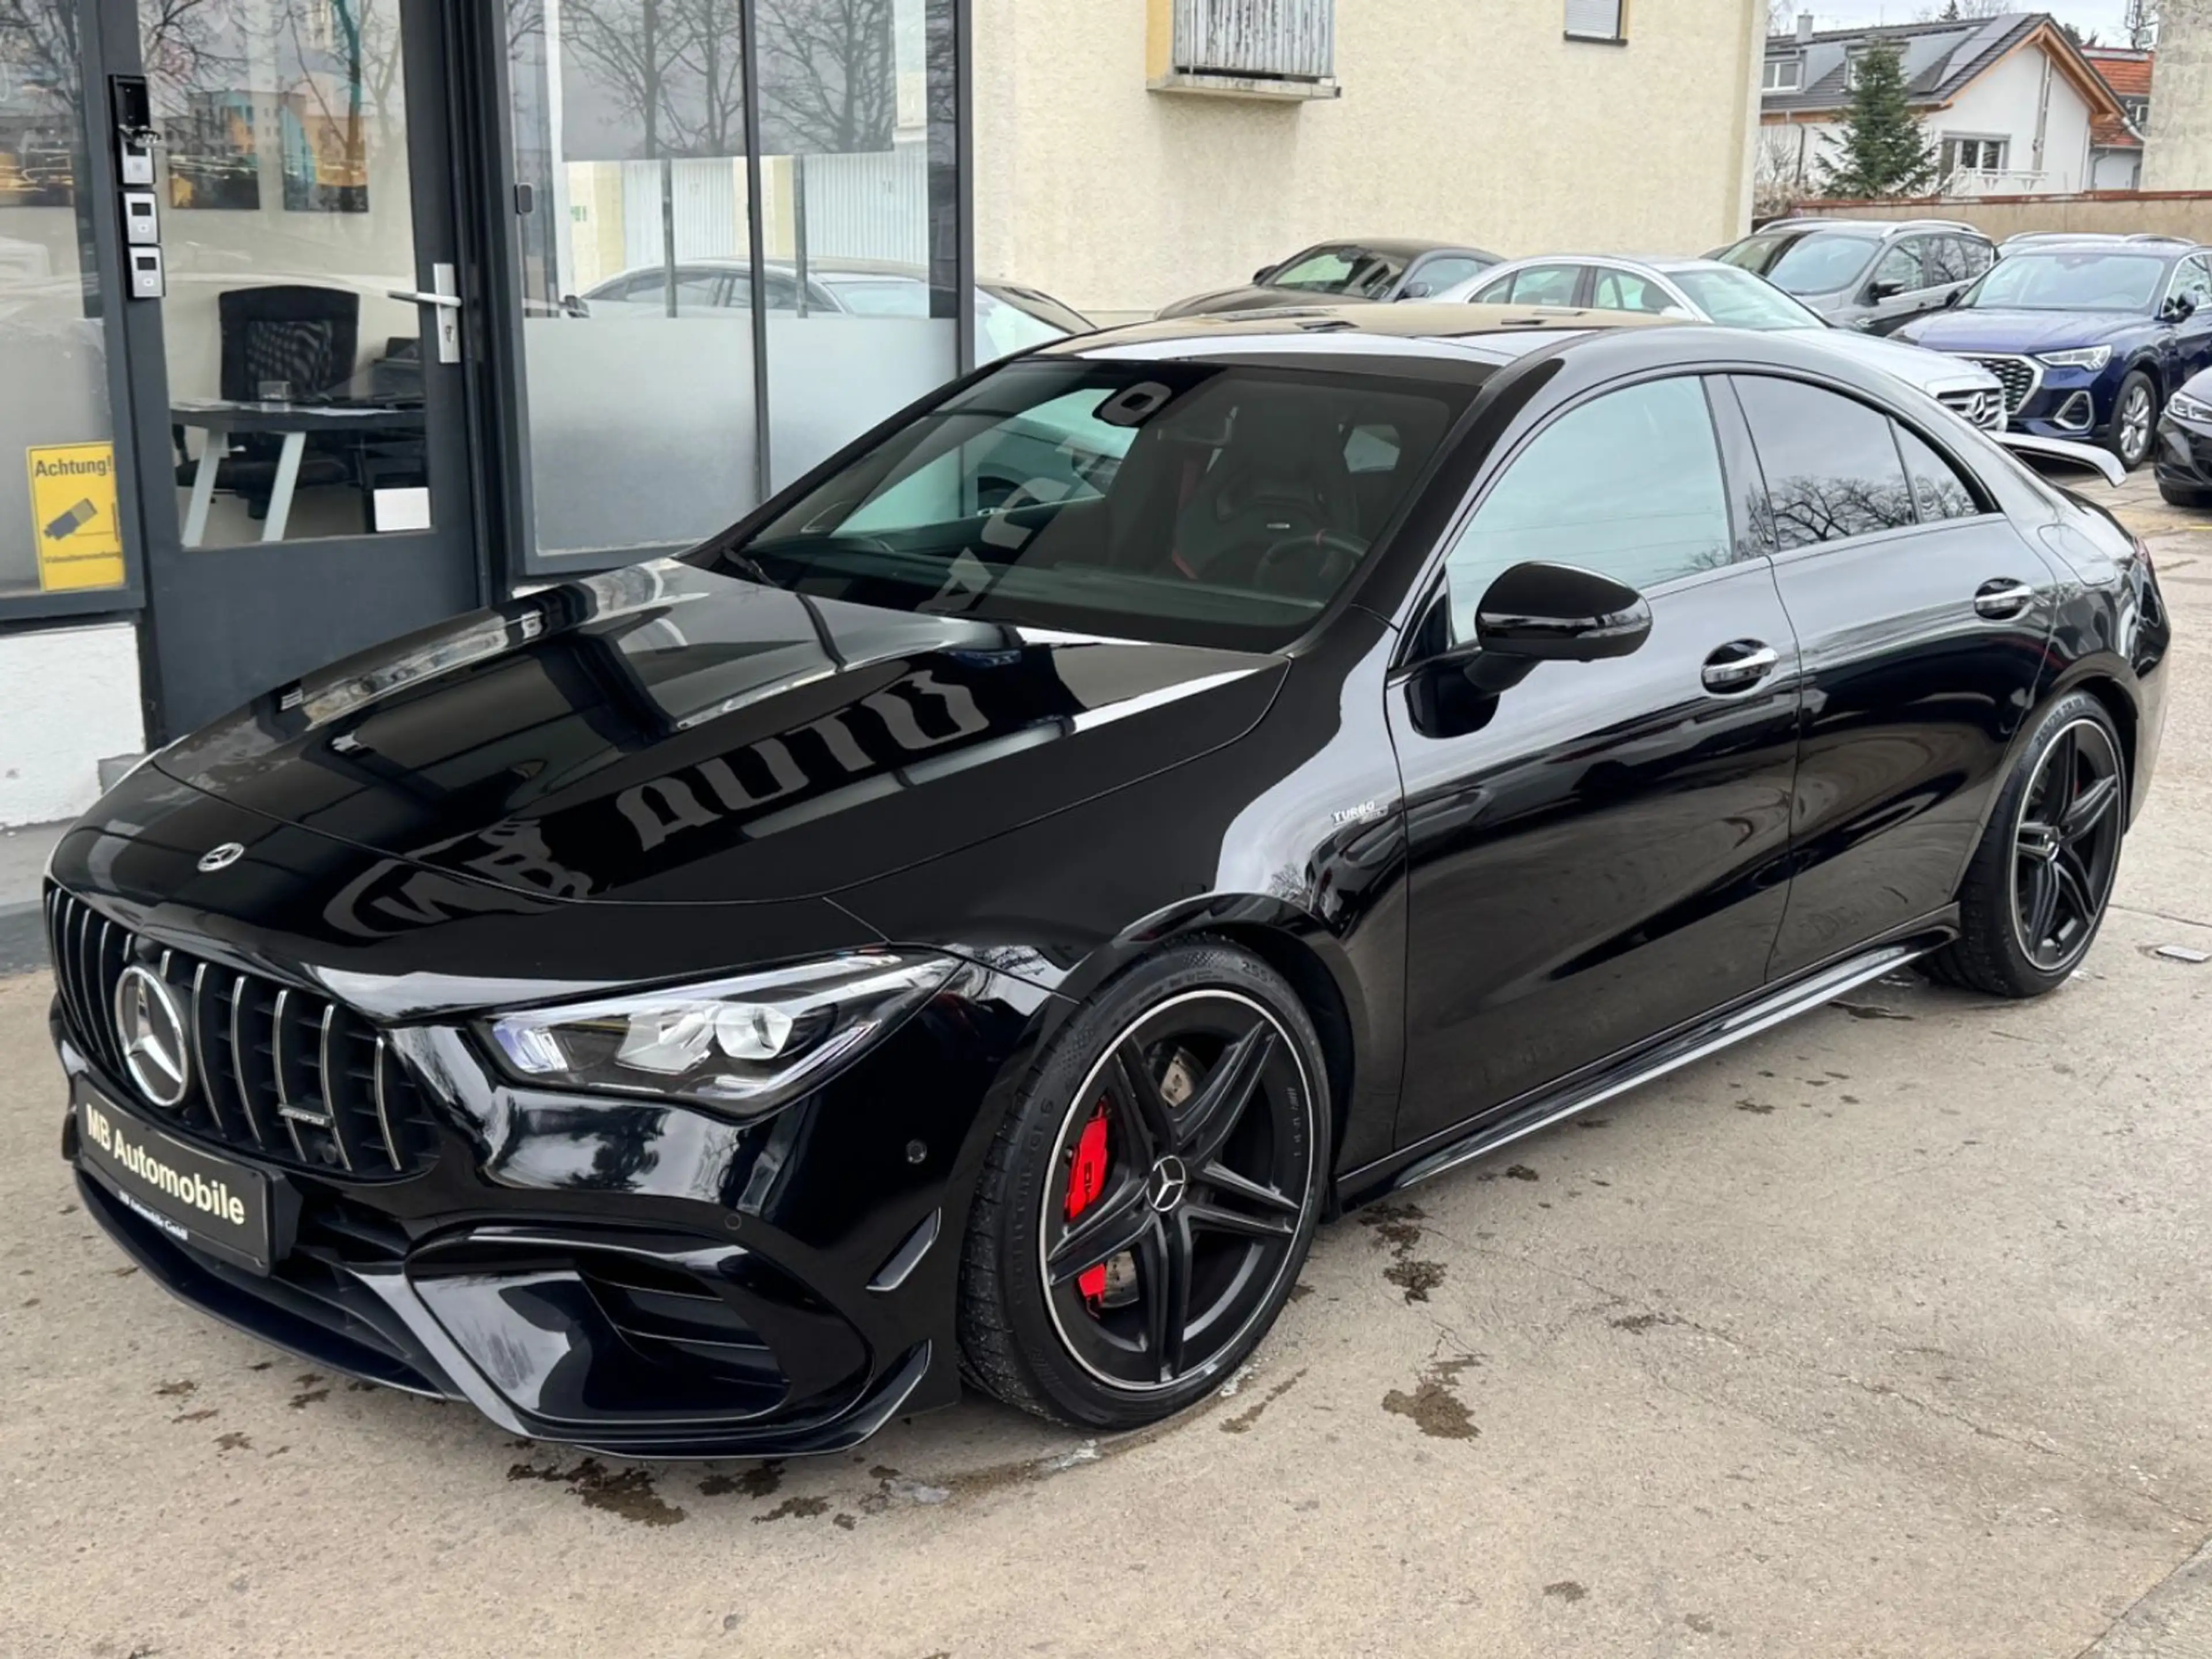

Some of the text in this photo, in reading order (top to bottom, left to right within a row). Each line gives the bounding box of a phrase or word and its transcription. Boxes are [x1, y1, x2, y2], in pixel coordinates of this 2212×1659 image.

[35, 454, 112, 476] Achtung!
[1333, 800, 1376, 823] TURBO
[85, 1103, 245, 1225] MB Automobile
